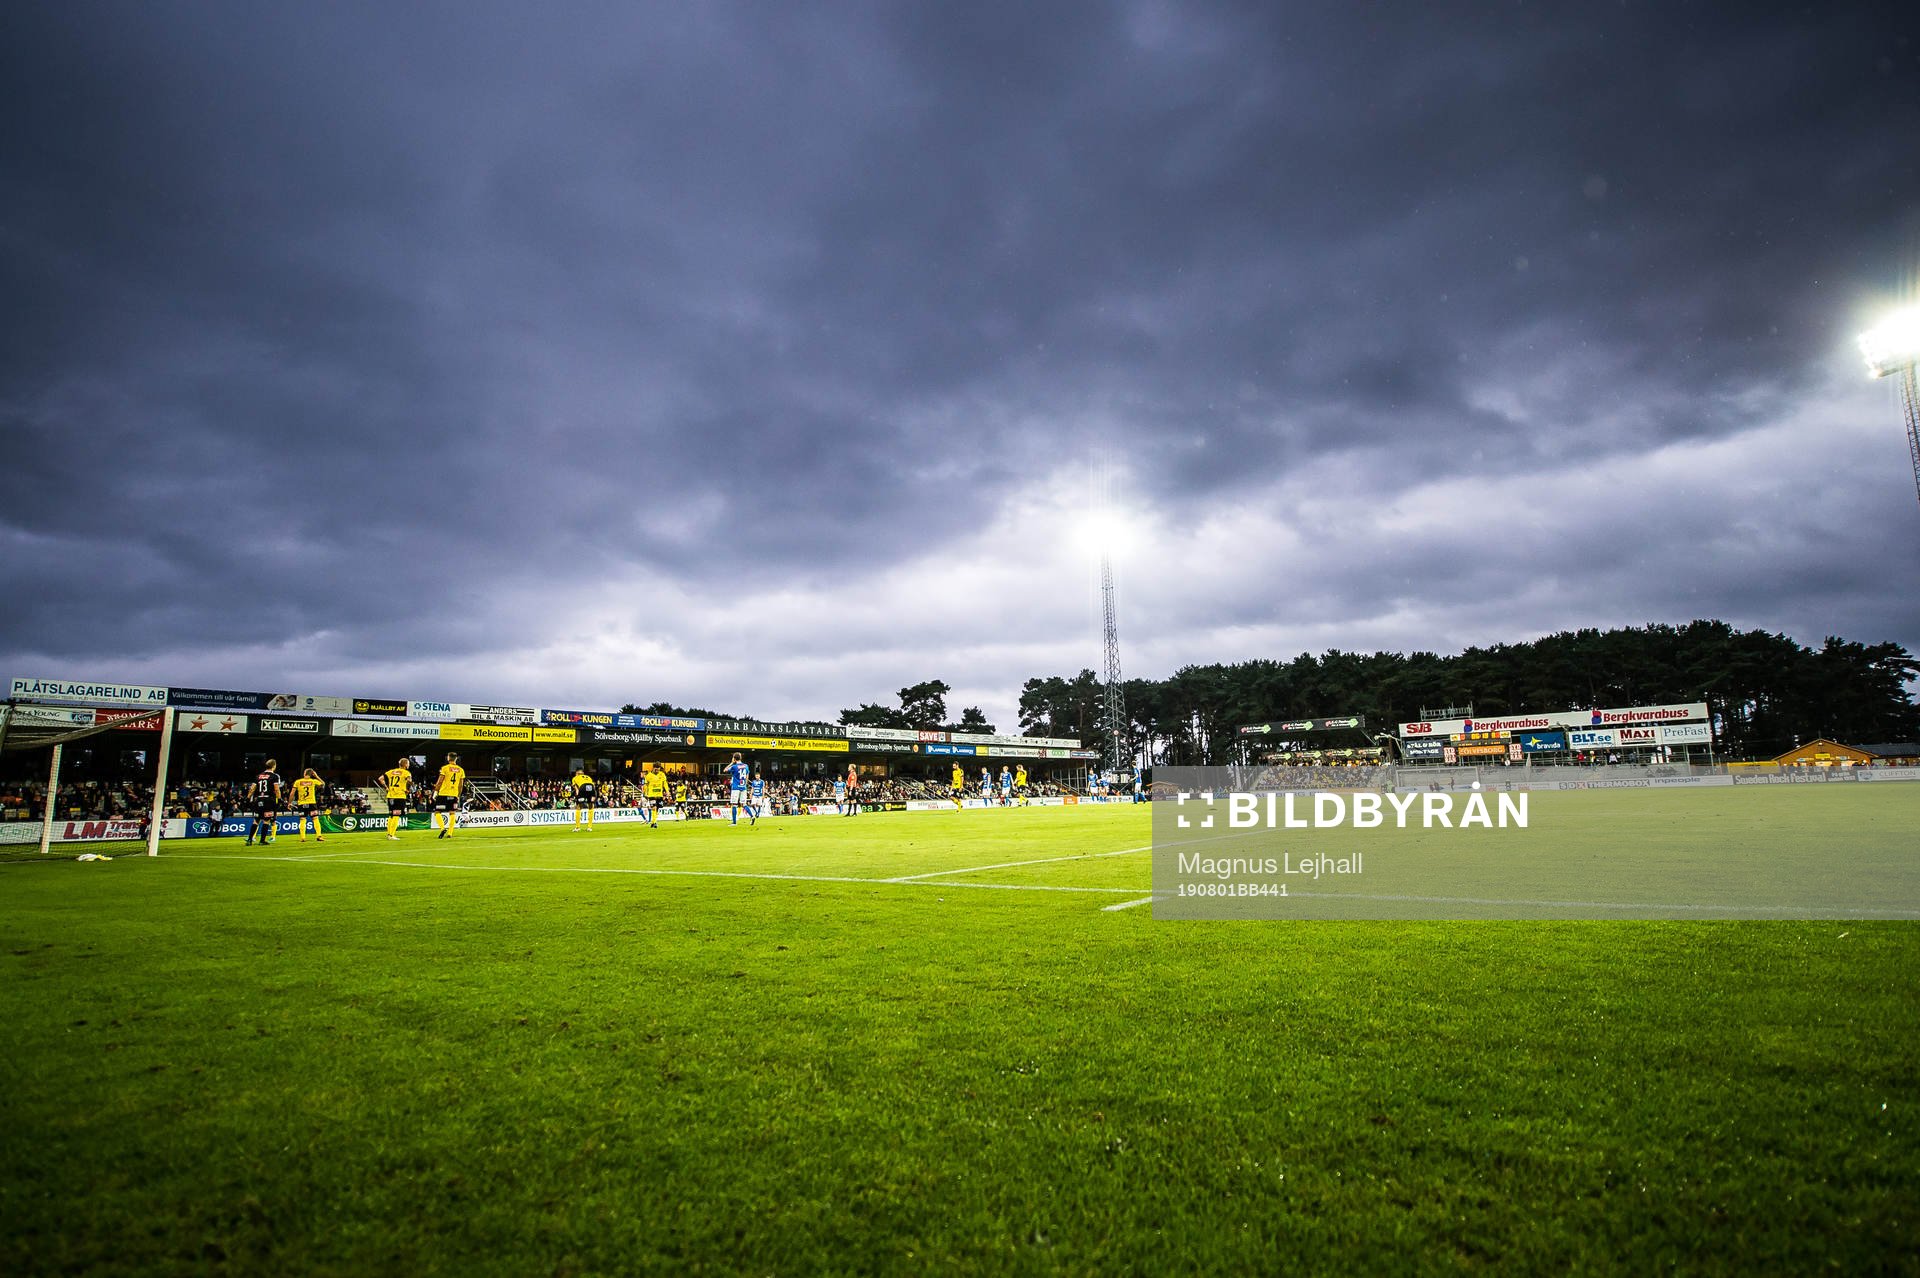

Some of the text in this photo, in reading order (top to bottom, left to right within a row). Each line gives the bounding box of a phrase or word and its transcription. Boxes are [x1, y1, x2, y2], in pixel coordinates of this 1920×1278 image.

[14, 680, 141, 700] PLÅTSLAGARELIND
[148, 690, 165, 701] AB
[172, 692, 213, 702] Välkommen
[214, 693, 224, 702] till
[422, 702, 451, 713] STENA
[489, 707, 518, 715] ANDERS
[492, 714, 522, 722] MASKIN
[523, 715, 534, 723] AB
[1603, 708, 1688, 723] Bergkvarabuss
[263, 719, 279, 730] XL
[1474, 718, 1549, 733] Bergkvarabuss
[473, 729, 529, 739] Mekonomen
[594, 731, 683, 745] Sölvesborg-Mjällby Sparbank
[1664, 726, 1708, 738] PreFast
[1536, 742, 1561, 750] bravida
[450, 773, 457, 785] 4
[738, 768, 747, 779] 14
[1735, 774, 1768, 784] Sweden
[1768, 772, 1790, 784] Rock
[258, 779, 268, 792] 13
[390, 775, 400, 788] 12
[1587, 779, 1650, 789] THERMOBOX
[303, 786, 310, 799] 3
[63, 821, 108, 840] LM
[282, 820, 314, 831] OBS
